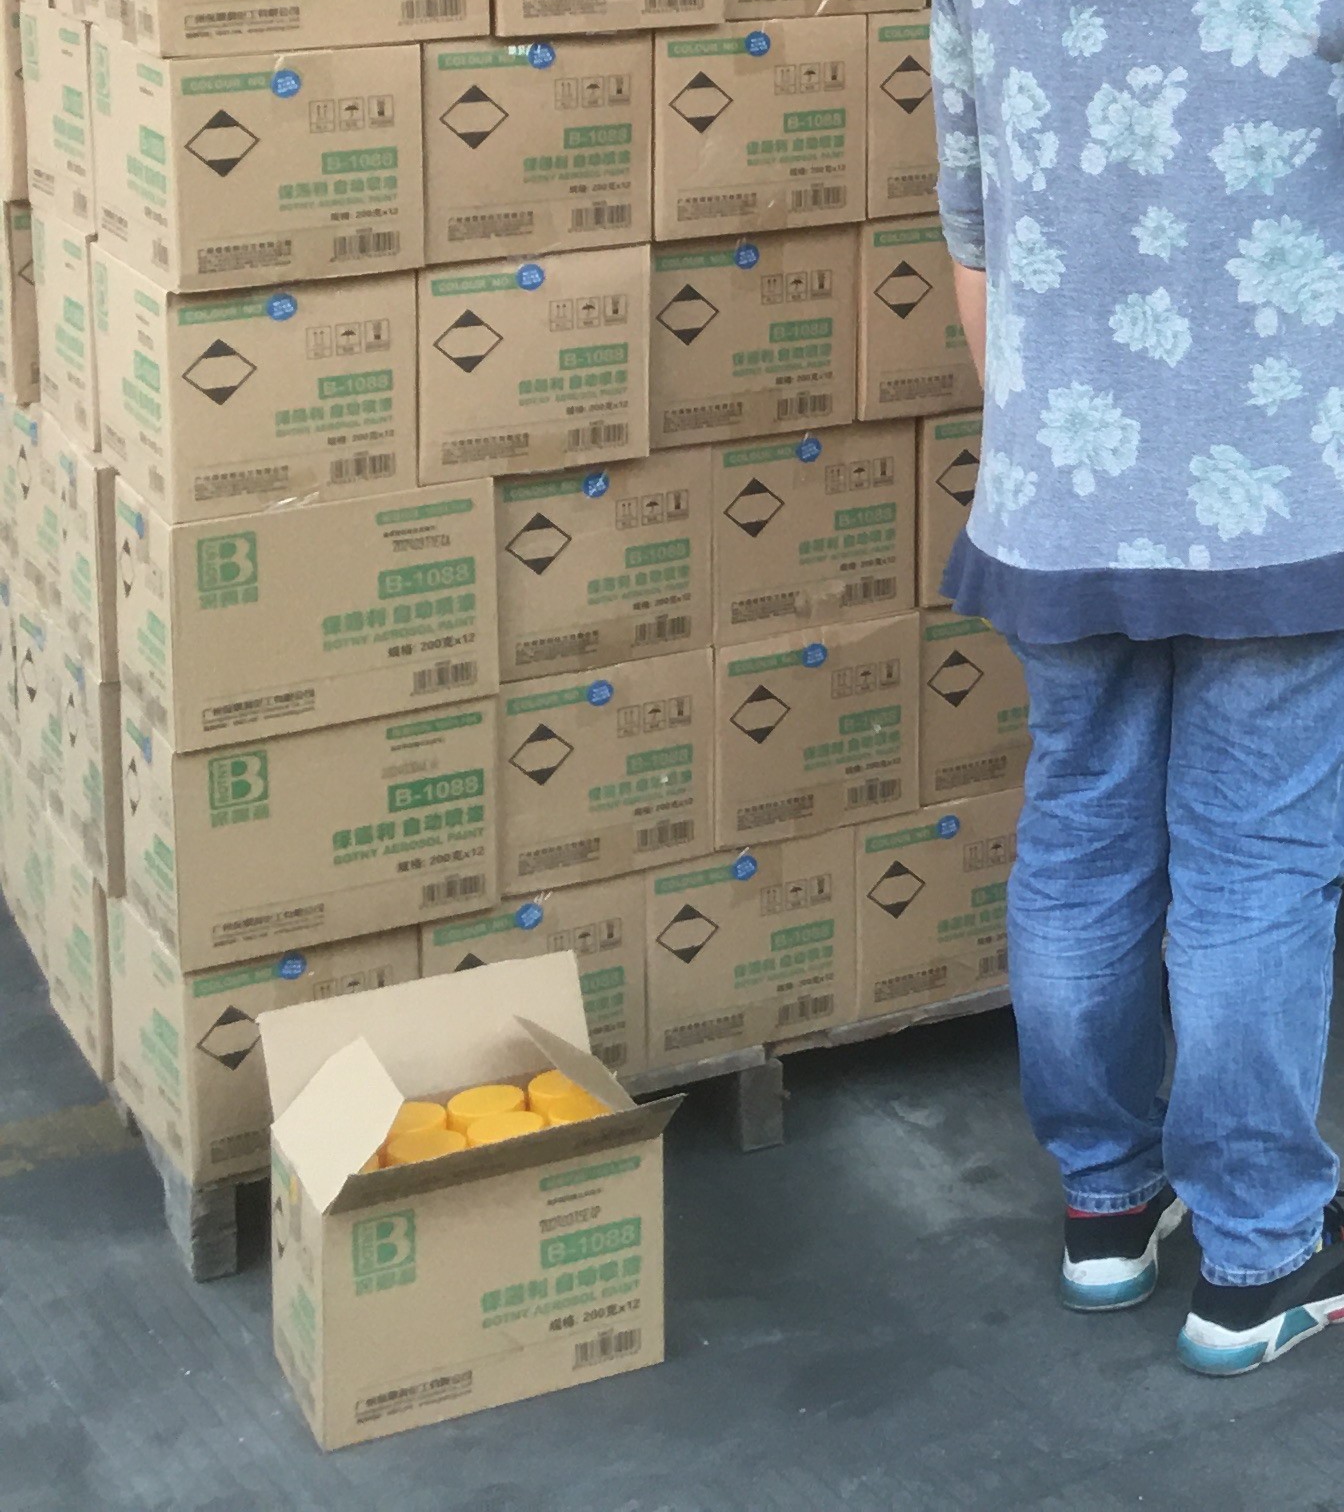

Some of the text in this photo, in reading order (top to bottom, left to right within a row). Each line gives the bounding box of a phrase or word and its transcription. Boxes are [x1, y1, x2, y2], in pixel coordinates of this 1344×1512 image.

[384, 564, 471, 592] B-1088
[395, 777, 480, 807] B-1088
[549, 1226, 637, 1260] B-1088
